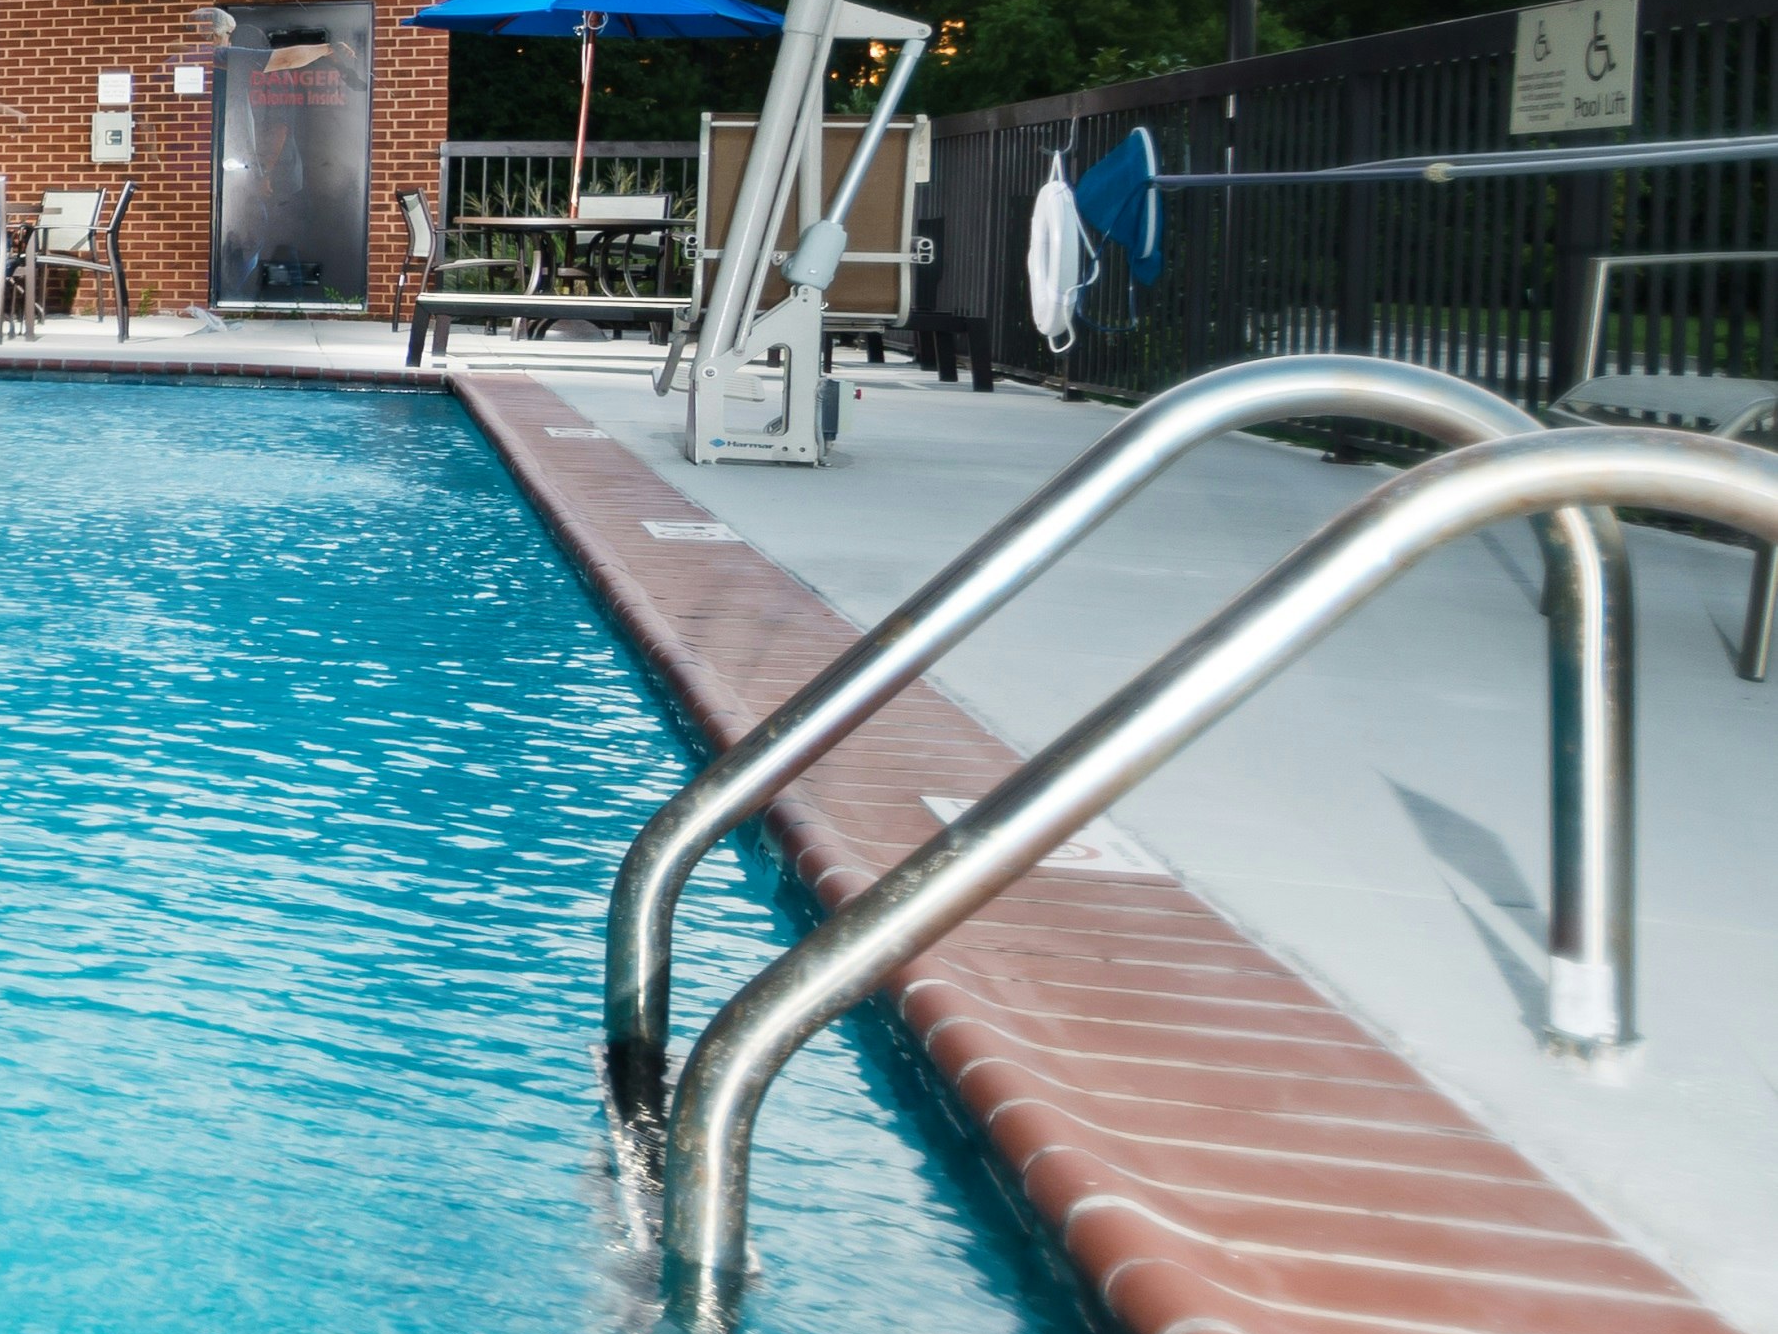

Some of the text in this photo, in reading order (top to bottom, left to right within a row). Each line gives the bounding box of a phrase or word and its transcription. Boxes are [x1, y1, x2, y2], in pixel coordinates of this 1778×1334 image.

[1573, 94, 1600, 118] Pool
[1605, 90, 1627, 115] Lift
[728, 441, 774, 449] Harmar
